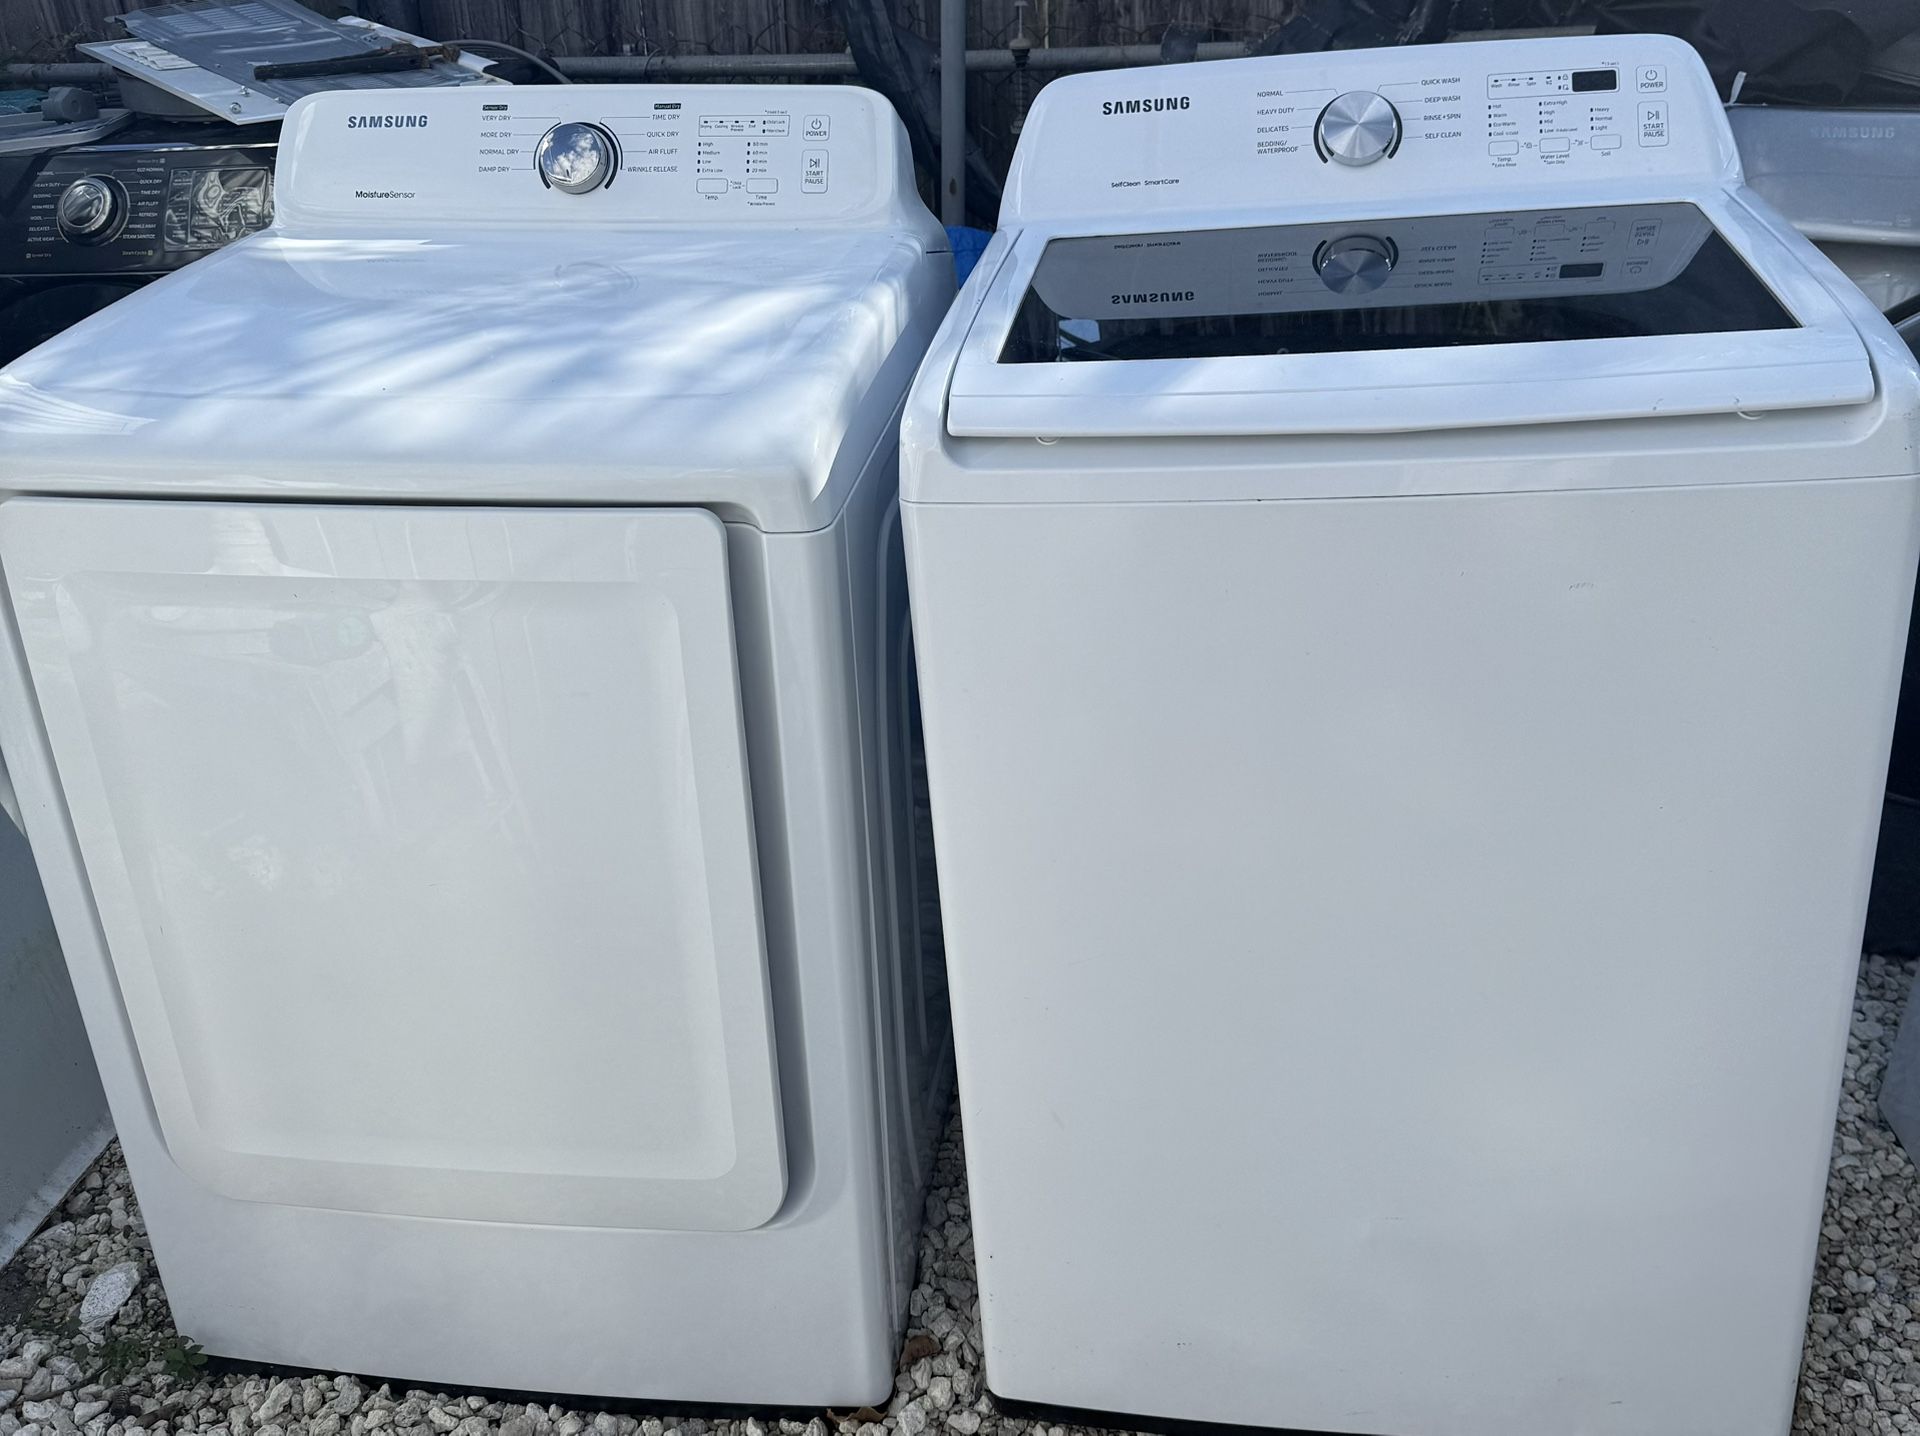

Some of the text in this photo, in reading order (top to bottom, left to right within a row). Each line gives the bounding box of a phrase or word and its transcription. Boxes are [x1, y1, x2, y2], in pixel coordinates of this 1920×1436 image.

[1102, 96, 1190, 116] SAMSUNG
[348, 115, 428, 129] SAMSUNG
[1643, 122, 1664, 130] START
[1257, 140, 1288, 148] BEDDING/
[1257, 146, 1299, 155] WATERPROOF
[1144, 178, 1179, 186] SmartCare
[355, 190, 416, 199] MoistureSensor
